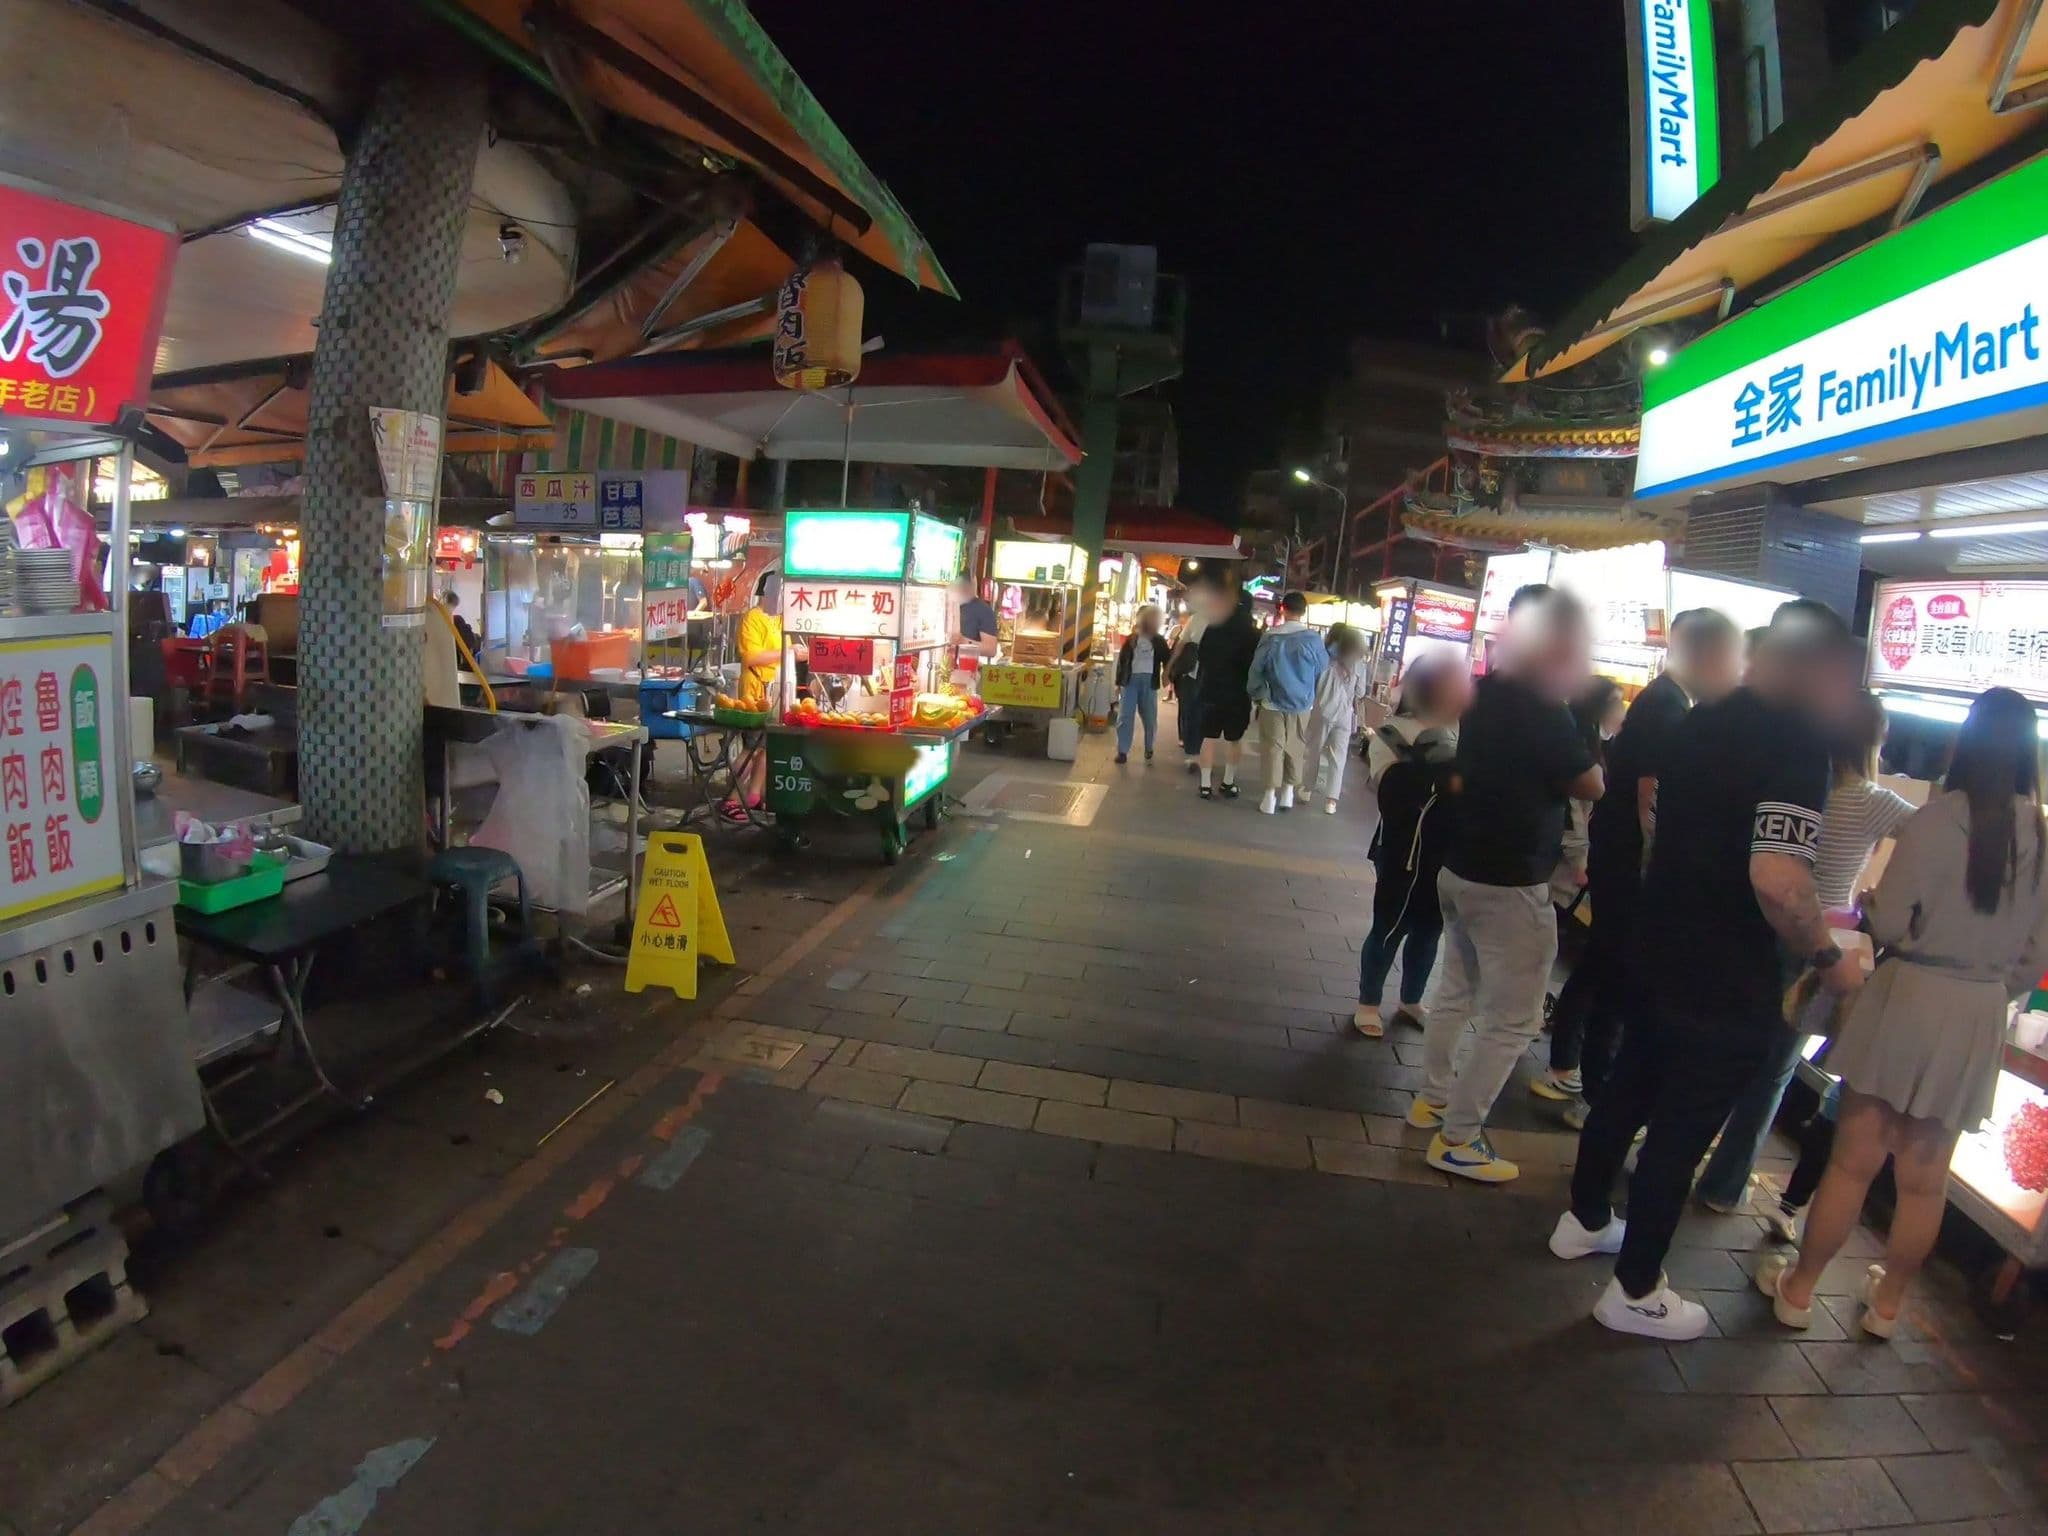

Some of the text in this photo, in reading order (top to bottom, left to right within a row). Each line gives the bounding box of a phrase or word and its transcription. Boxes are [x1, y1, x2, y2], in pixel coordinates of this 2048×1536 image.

[1652, 0, 1689, 167] amilyMart
[0, 236, 110, 379] 湯
[1731, 302, 2040, 448] 全家 FamilyMart
[520, 479, 591, 499] 西瓜汁
[562, 503, 578, 520] 35
[790, 586, 895, 615] 木瓜牛奶
[646, 599, 688, 626] 木瓜牛奶
[987, 668, 1055, 688] 好吃肉包
[36, 670, 74, 874] 魯肉飯
[773, 756, 803, 771] 一份
[774, 775, 812, 792] 50元
[654, 867, 686, 879] CAUTION
[648, 878, 689, 889] WET FLOOR
[640, 931, 688, 952] 小心地滑
